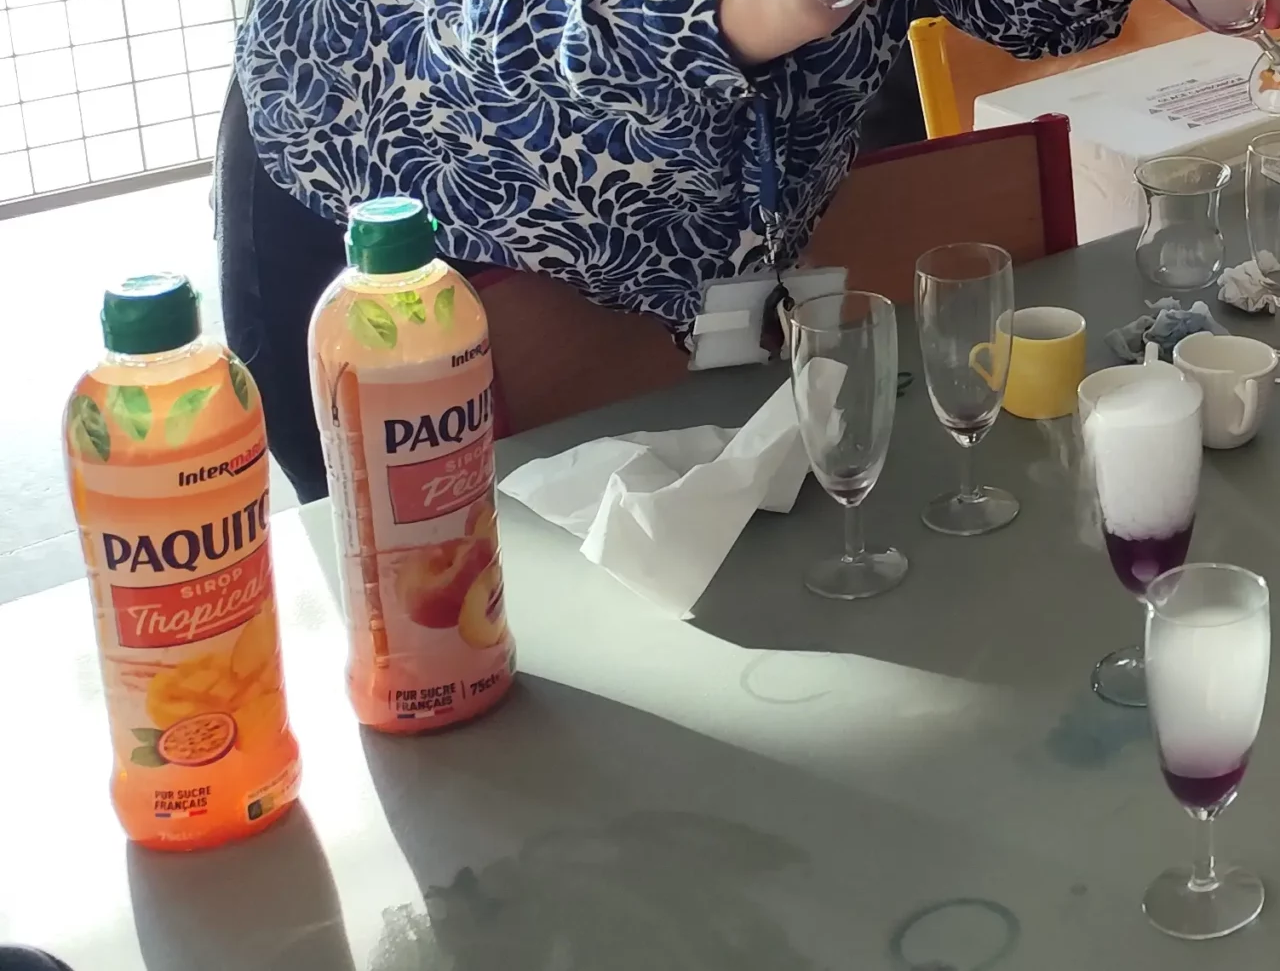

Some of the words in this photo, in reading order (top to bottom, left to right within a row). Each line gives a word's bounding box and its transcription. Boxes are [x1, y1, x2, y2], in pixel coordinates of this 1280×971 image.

[180, 567, 242, 599] SIROP
[127, 556, 269, 639] Tropical
[396, 690, 417, 701] PUR
[420, 682, 456, 698] SUCRE
[396, 696, 453, 711] FRANÇAIS
[155, 790, 174, 799] PUR
[178, 786, 211, 798] SUCRE
[154, 797, 208, 811] FRANÇAIS
